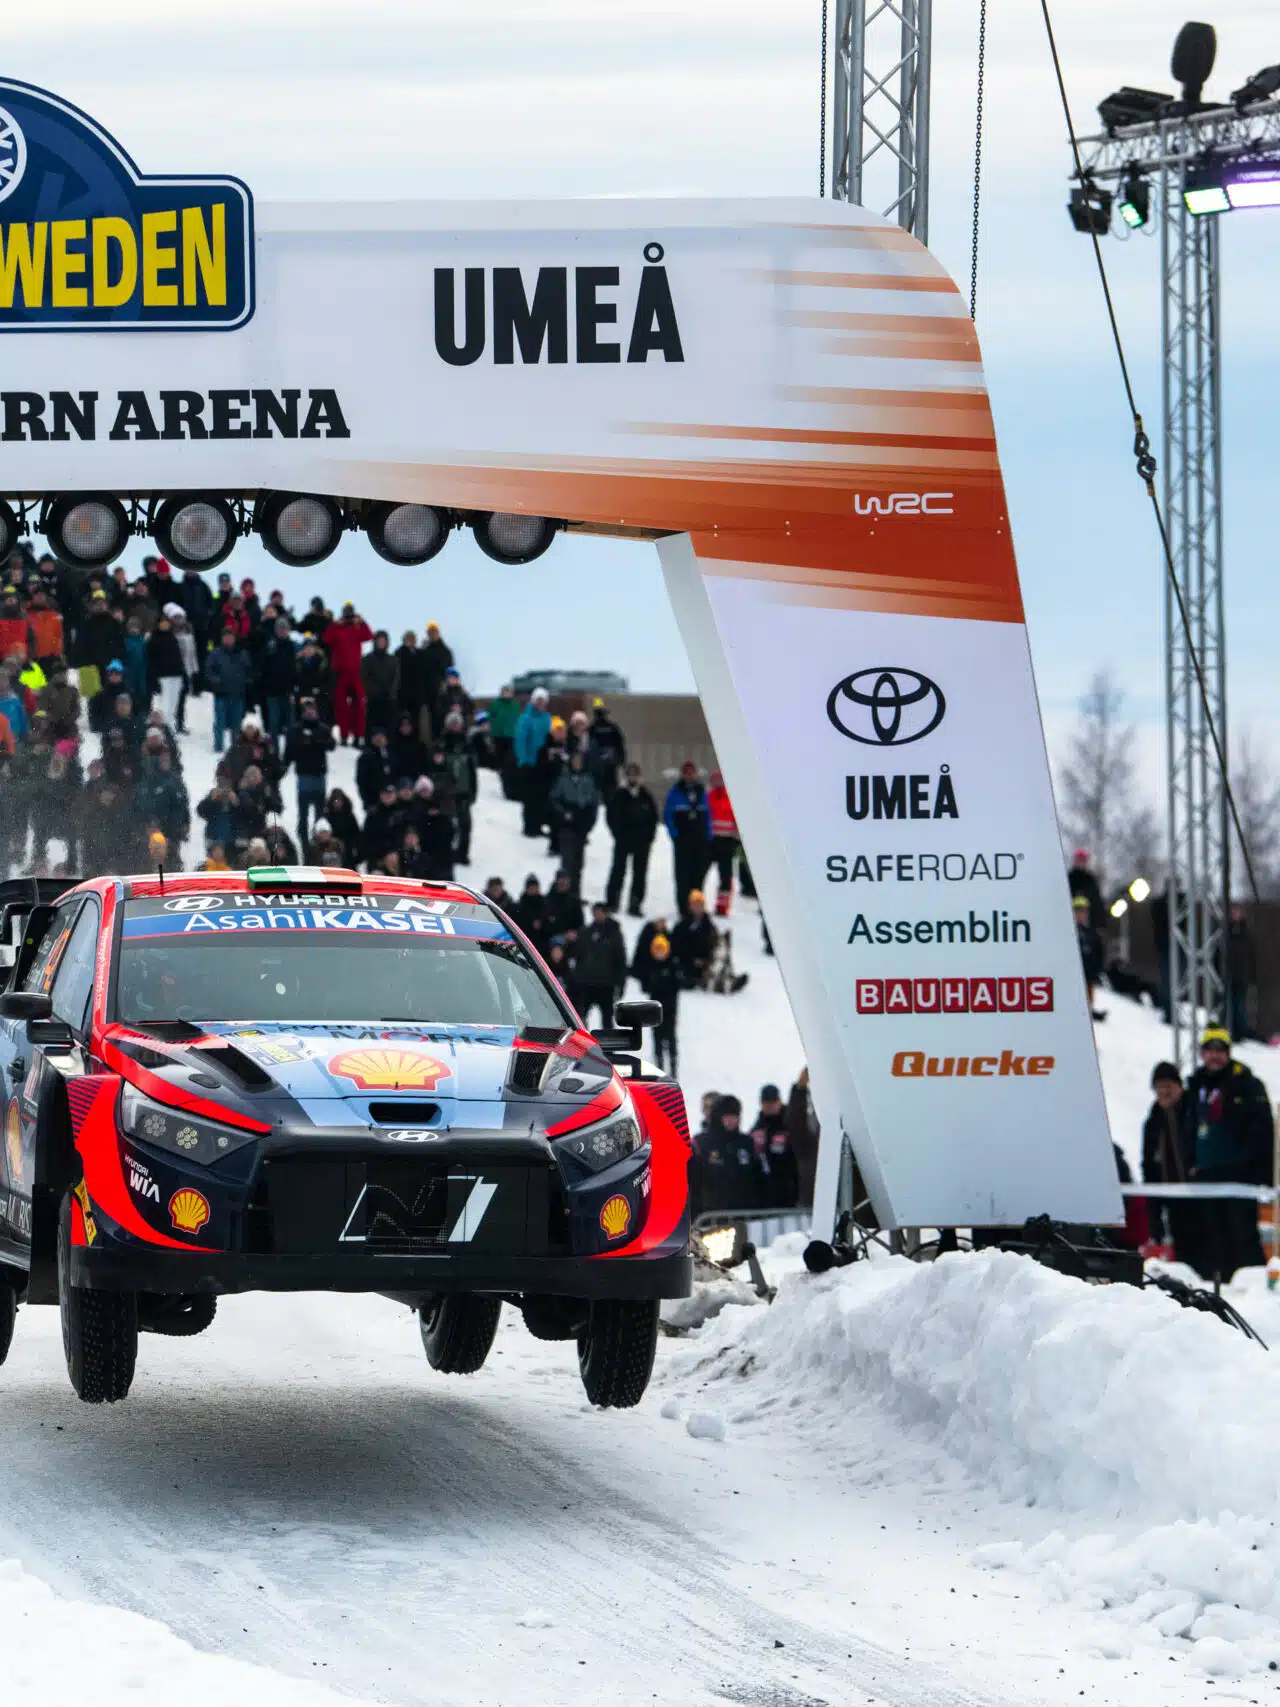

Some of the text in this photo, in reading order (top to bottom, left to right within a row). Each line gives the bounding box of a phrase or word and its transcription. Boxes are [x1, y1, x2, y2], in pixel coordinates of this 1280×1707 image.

[433, 241, 685, 367] UMEÅ
[108, 388, 351, 441] ARENA
[854, 492, 954, 515] WRC
[845, 763, 960, 820] UMEÅ
[826, 853, 1018, 883] SAFEROAD
[183, 908, 456, 936] AsahiKASEI
[847, 910, 1032, 945] Assemblin
[858, 979, 1052, 1011] BAUHAUS
[891, 1049, 1056, 1078] Quicke
[130, 1169, 160, 1203] WIA
